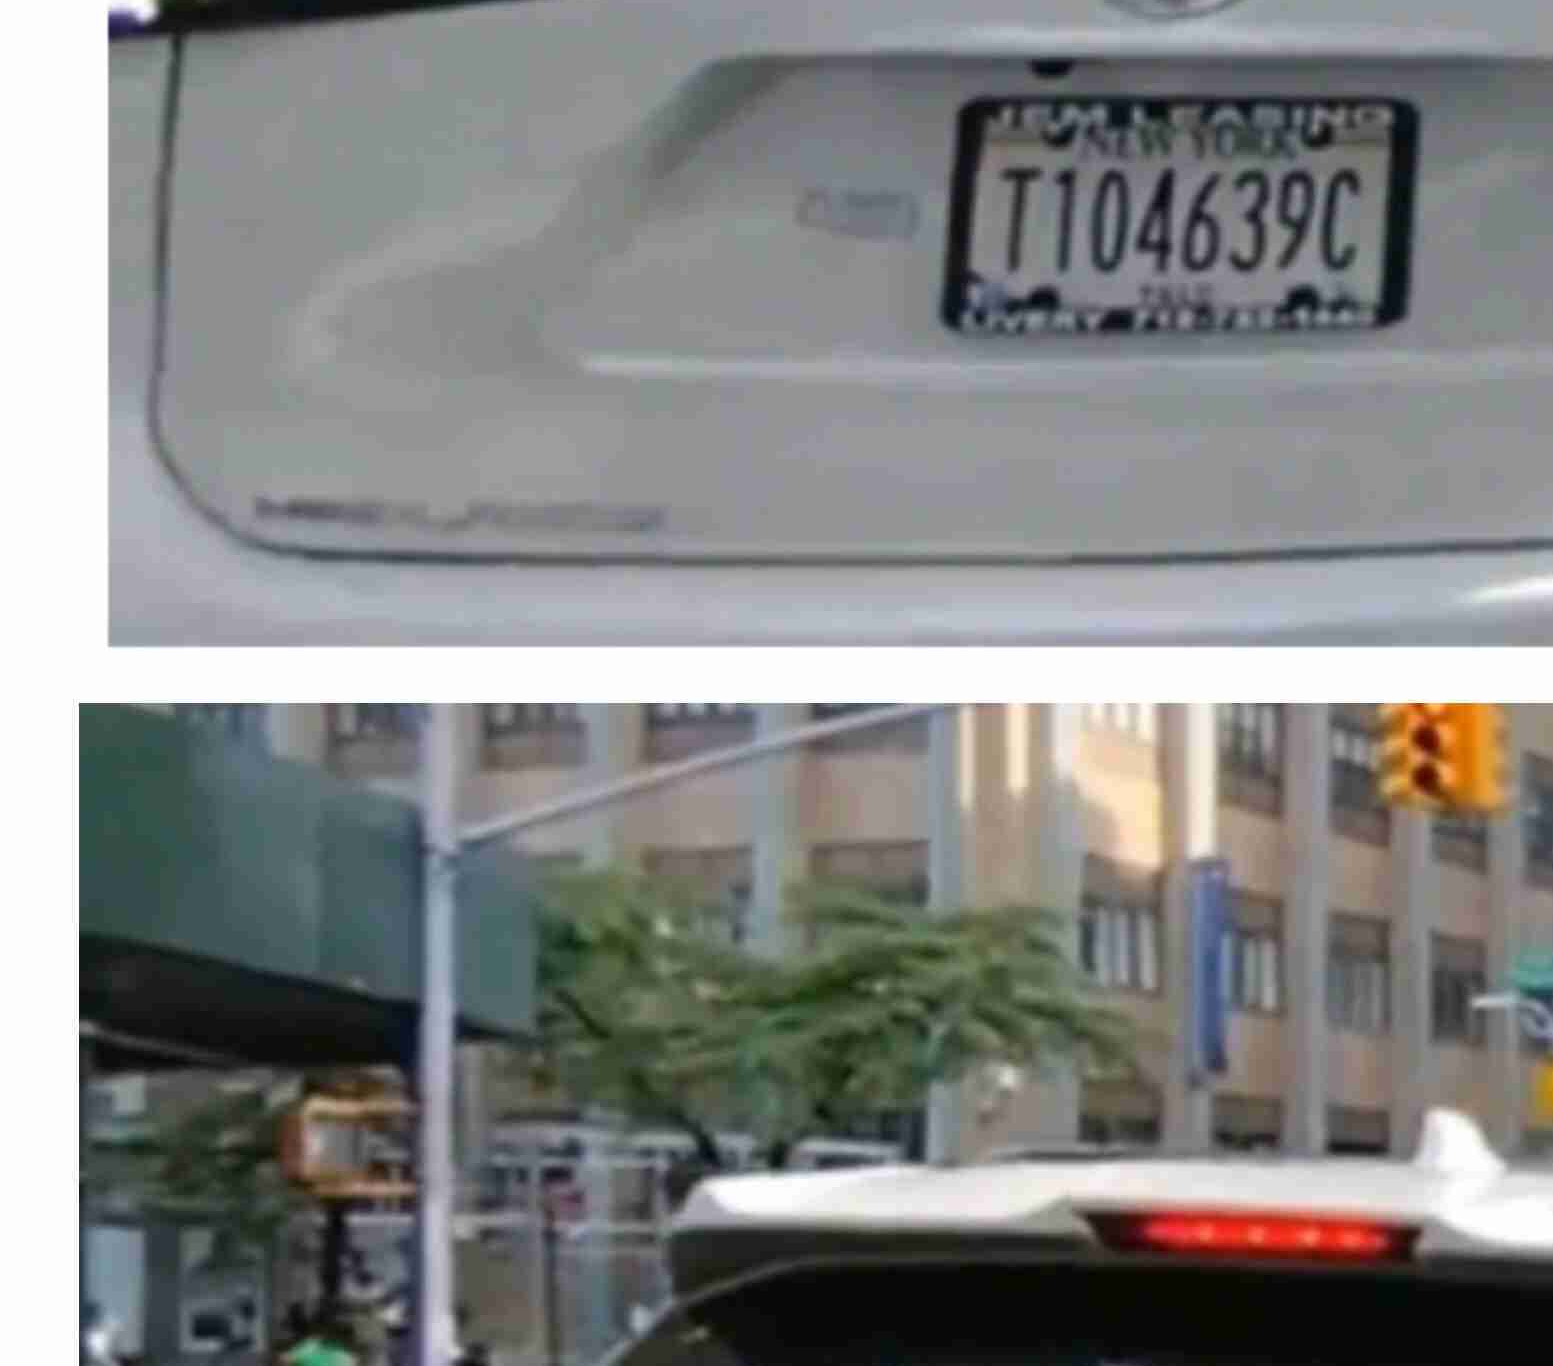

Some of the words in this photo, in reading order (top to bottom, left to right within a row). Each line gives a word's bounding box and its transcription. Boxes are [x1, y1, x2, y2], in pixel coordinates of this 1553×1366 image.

[1131, 102, 1395, 133] LEASING
[1081, 124, 1173, 160] NEW
[1190, 124, 1299, 160] YORK
[1000, 166, 1363, 273] T104639C
